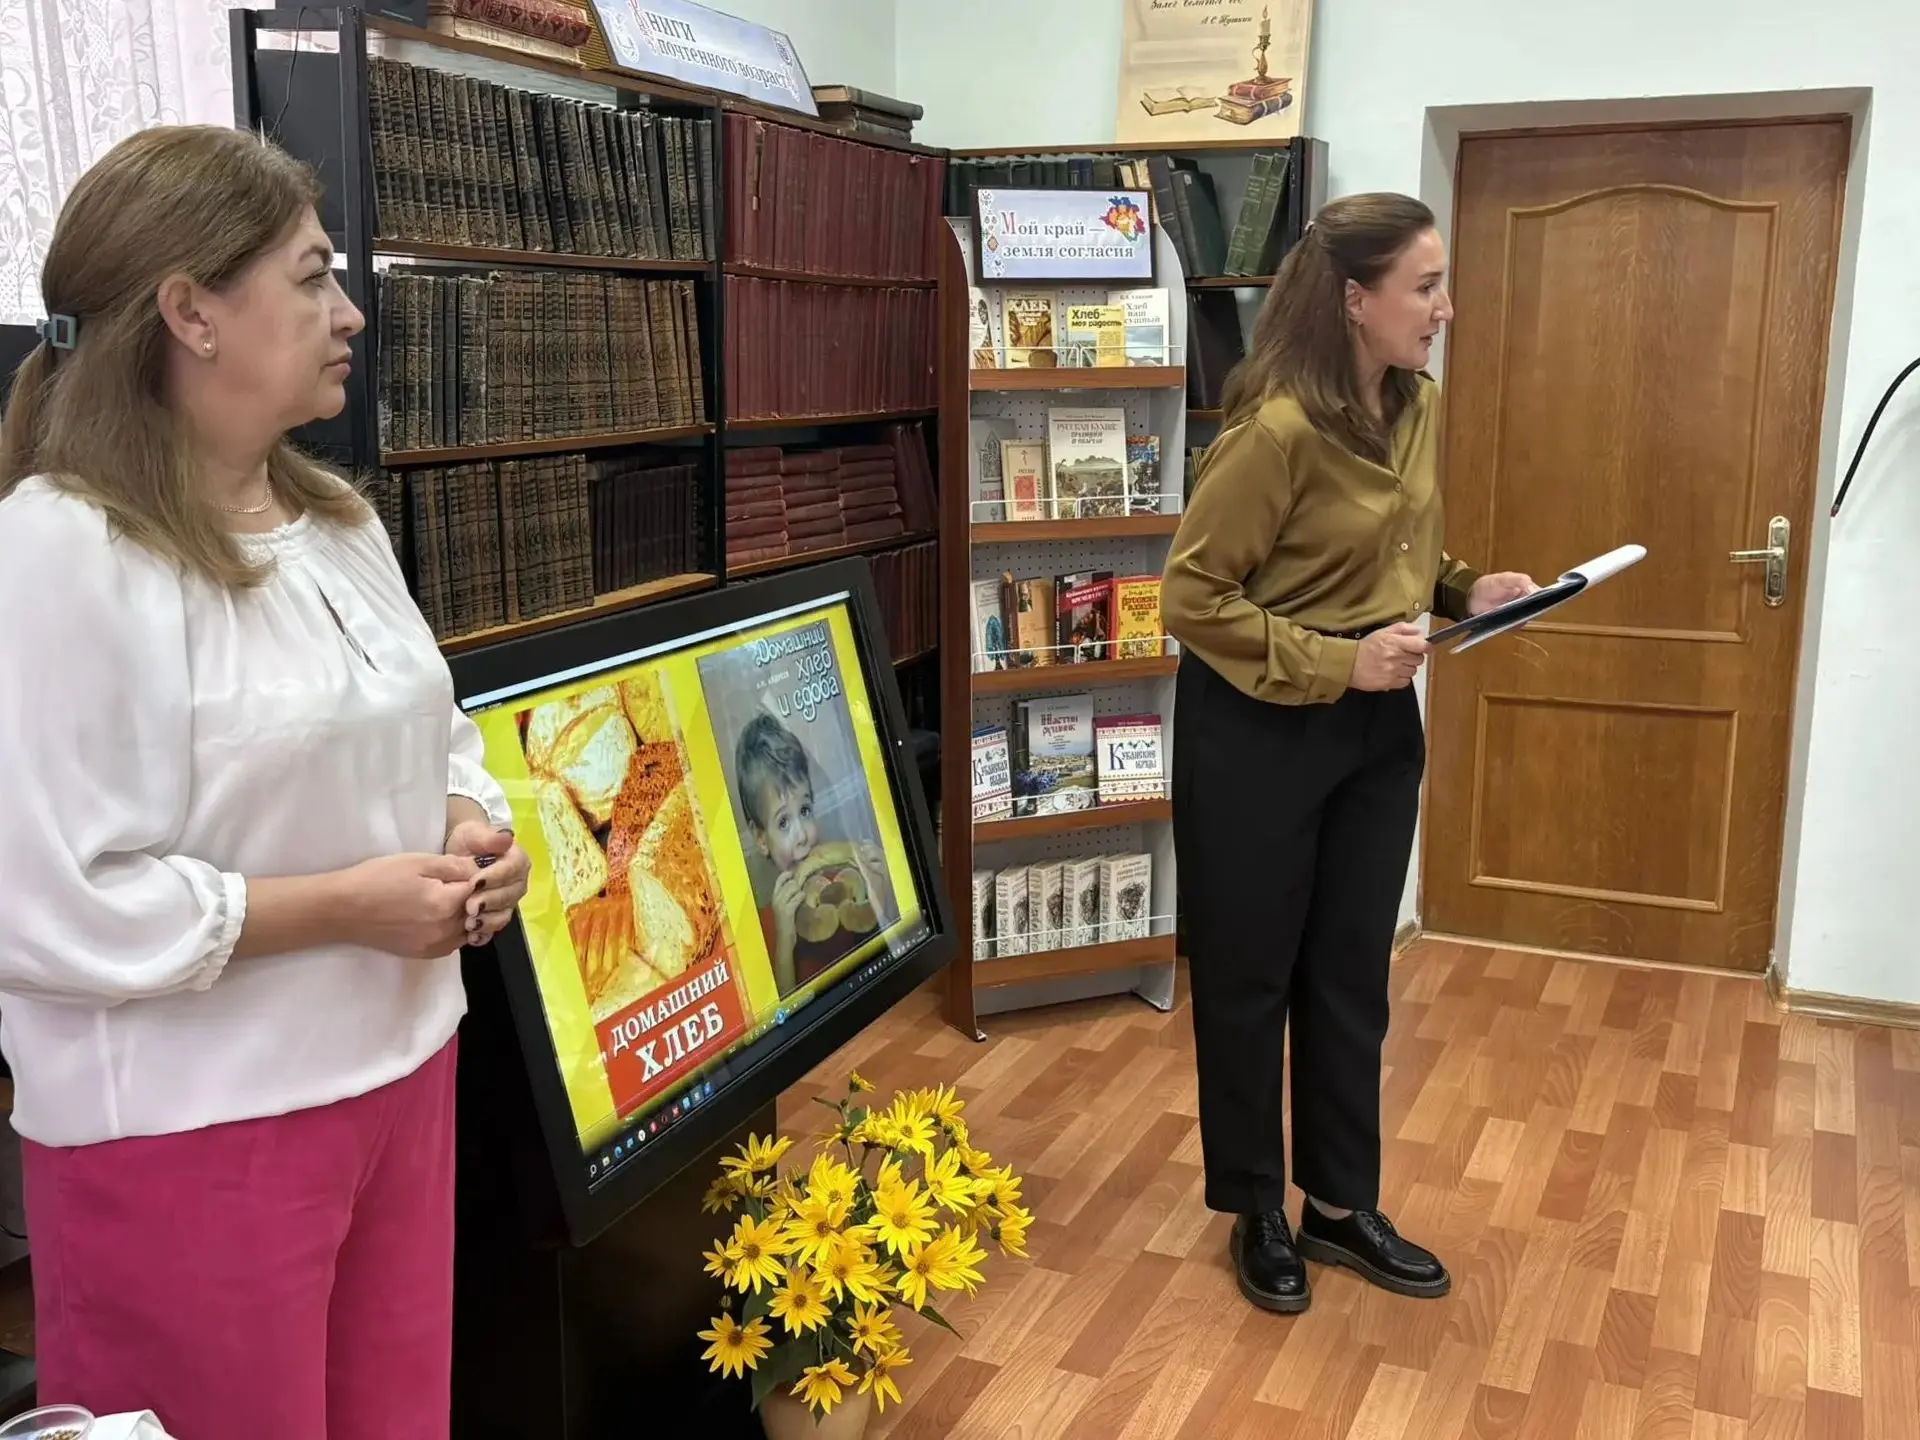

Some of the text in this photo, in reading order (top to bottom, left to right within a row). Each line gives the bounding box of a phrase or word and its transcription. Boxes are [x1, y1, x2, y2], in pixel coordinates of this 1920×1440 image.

[657, 38, 738, 75] почтенного
[1001, 212, 1038, 235] Мой
[1044, 222, 1084, 238] край
[1003, 246, 1133, 258] земля согласия
[1088, 320, 1122, 328] радость
[755, 622, 826, 667] Домашний
[793, 675, 840, 722] сдоба
[610, 958, 730, 1057] ДОМАШНИЙ
[635, 1001, 724, 1084] ХЛЕБ
